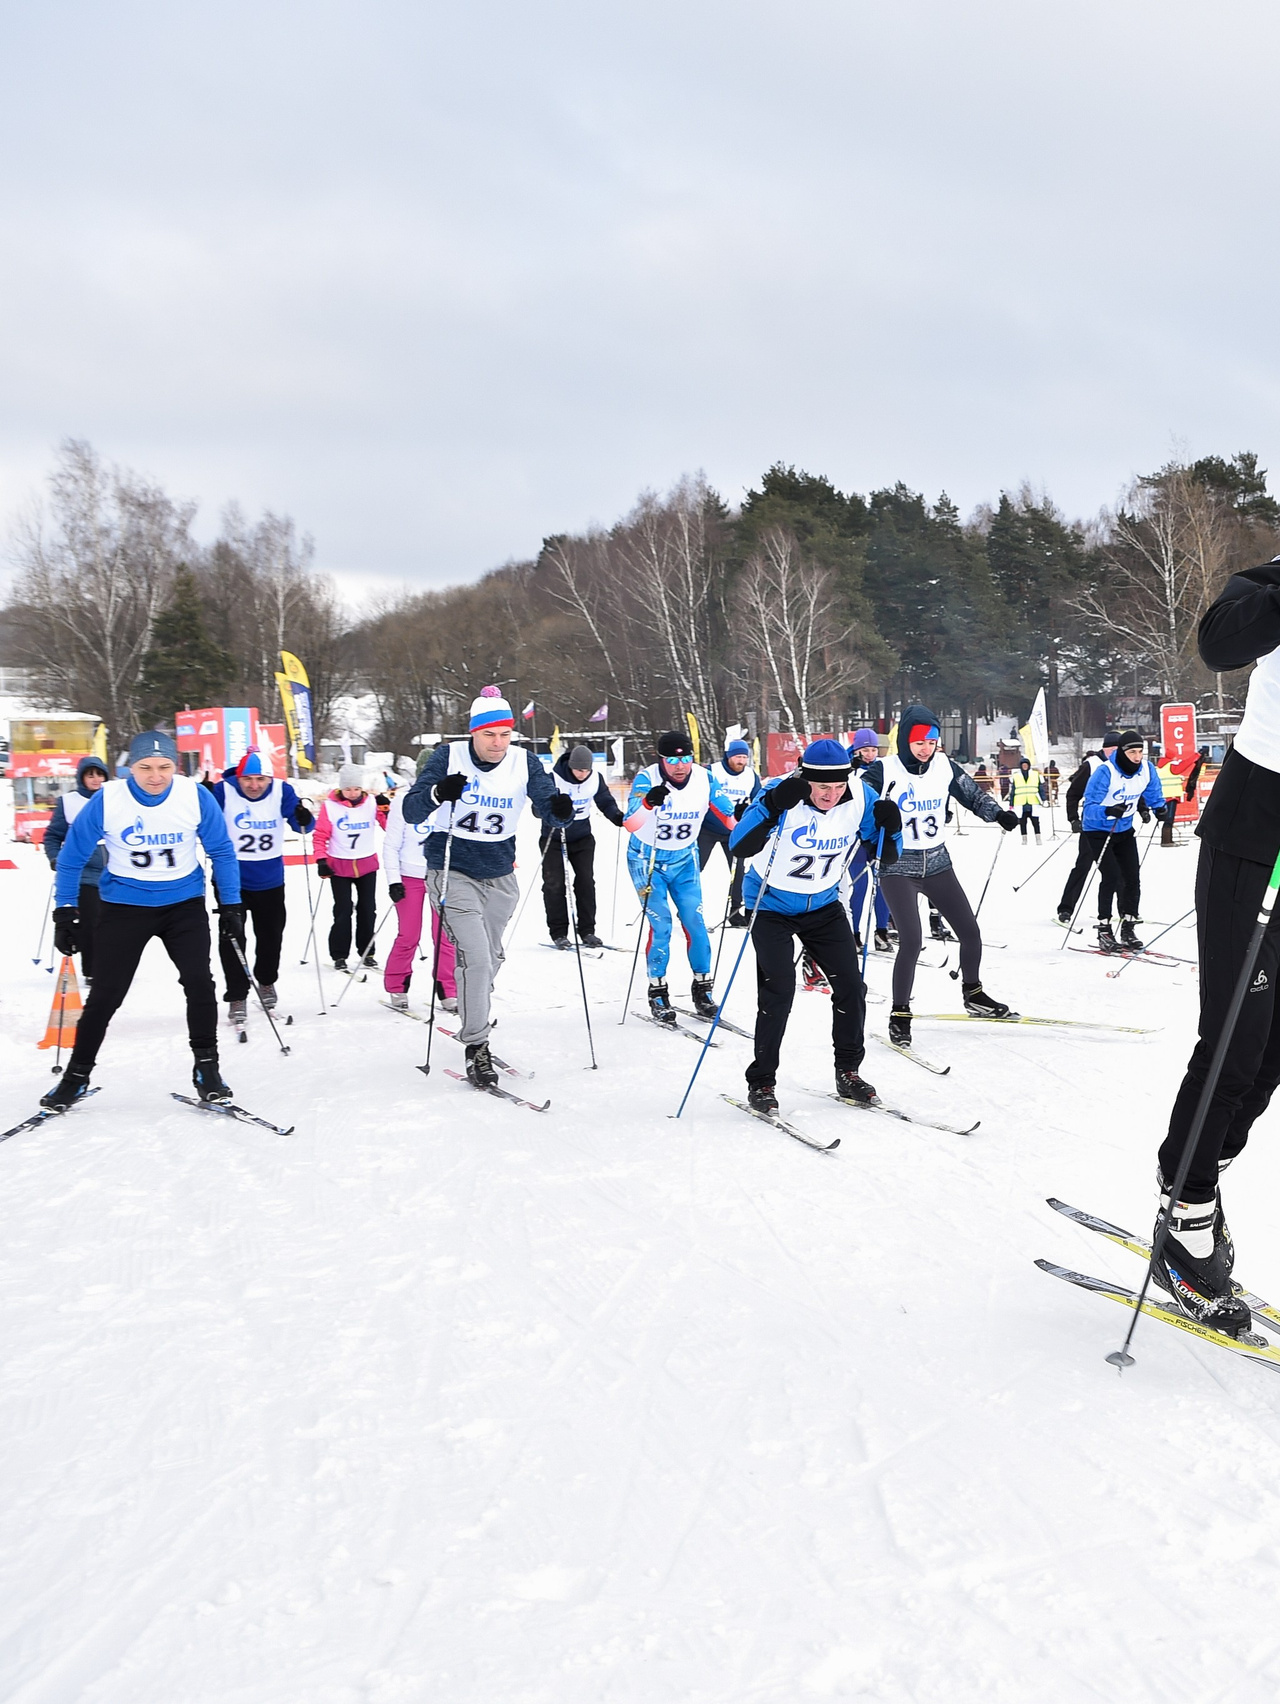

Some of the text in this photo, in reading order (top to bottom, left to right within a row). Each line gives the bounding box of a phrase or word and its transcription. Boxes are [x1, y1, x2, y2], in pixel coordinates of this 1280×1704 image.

[456, 810, 506, 835] 43
[657, 824, 693, 841] 38
[904, 814, 939, 841] 13
[237, 834, 274, 853] 28
[347, 834, 361, 849] 7
[130, 848, 177, 869] 51
[787, 851, 843, 881] 27
[1250, 984, 1270, 993] odlo
[1168, 1272, 1214, 1311] SALOMON
